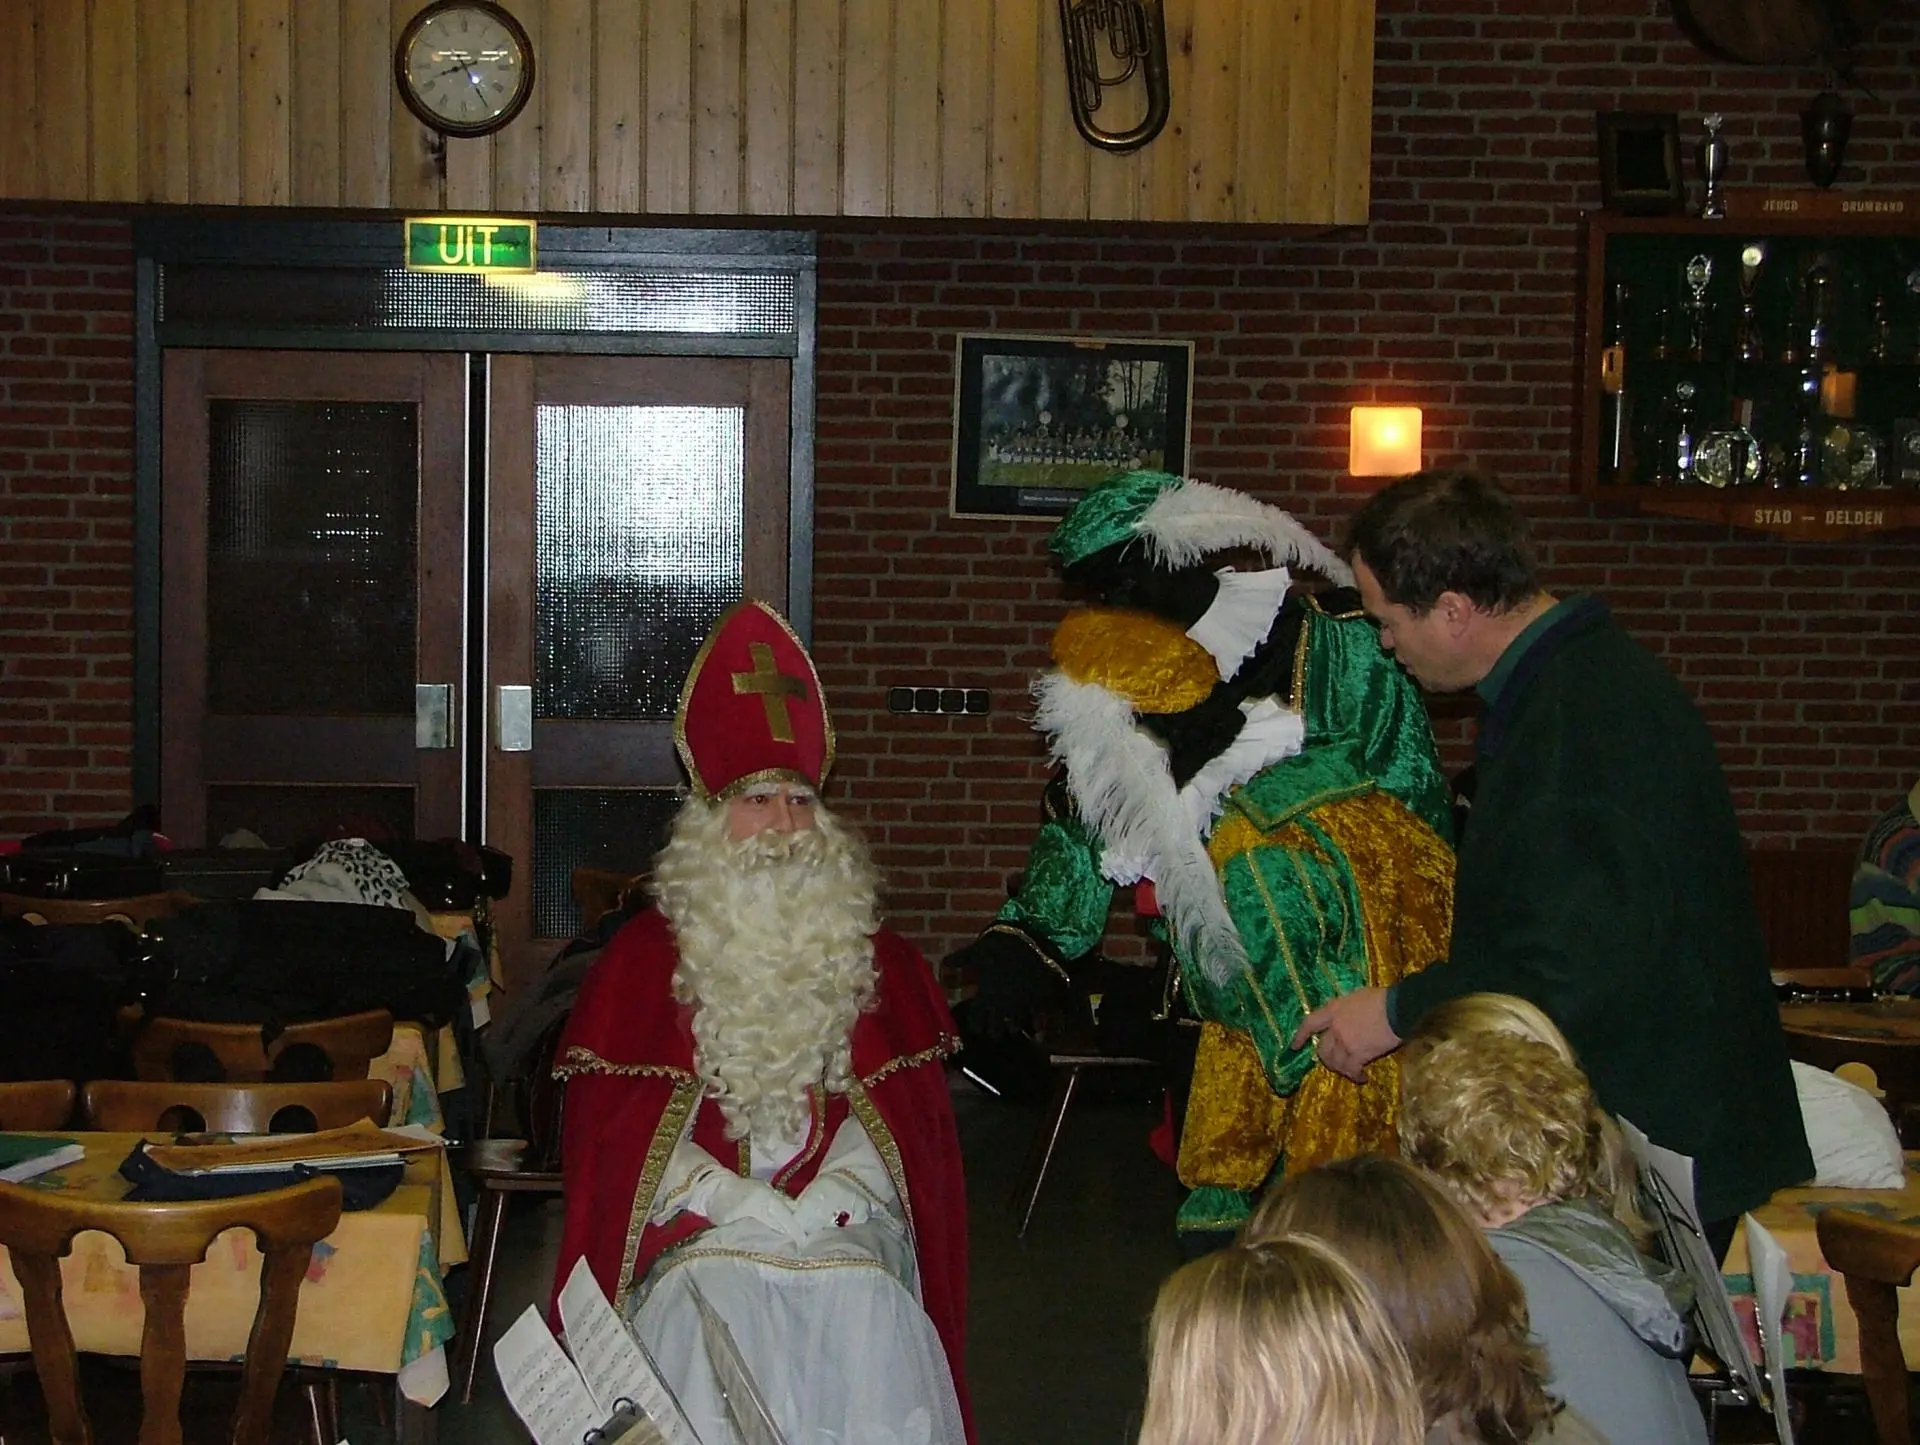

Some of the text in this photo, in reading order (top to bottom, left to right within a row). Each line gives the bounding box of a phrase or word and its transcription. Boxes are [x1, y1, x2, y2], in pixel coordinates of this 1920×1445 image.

[1841, 200, 1904, 213] DRUMBAND
[440, 225, 499, 266] UIT
[1754, 509, 1792, 525] STAD
[1825, 510, 1884, 525] DELDEN
